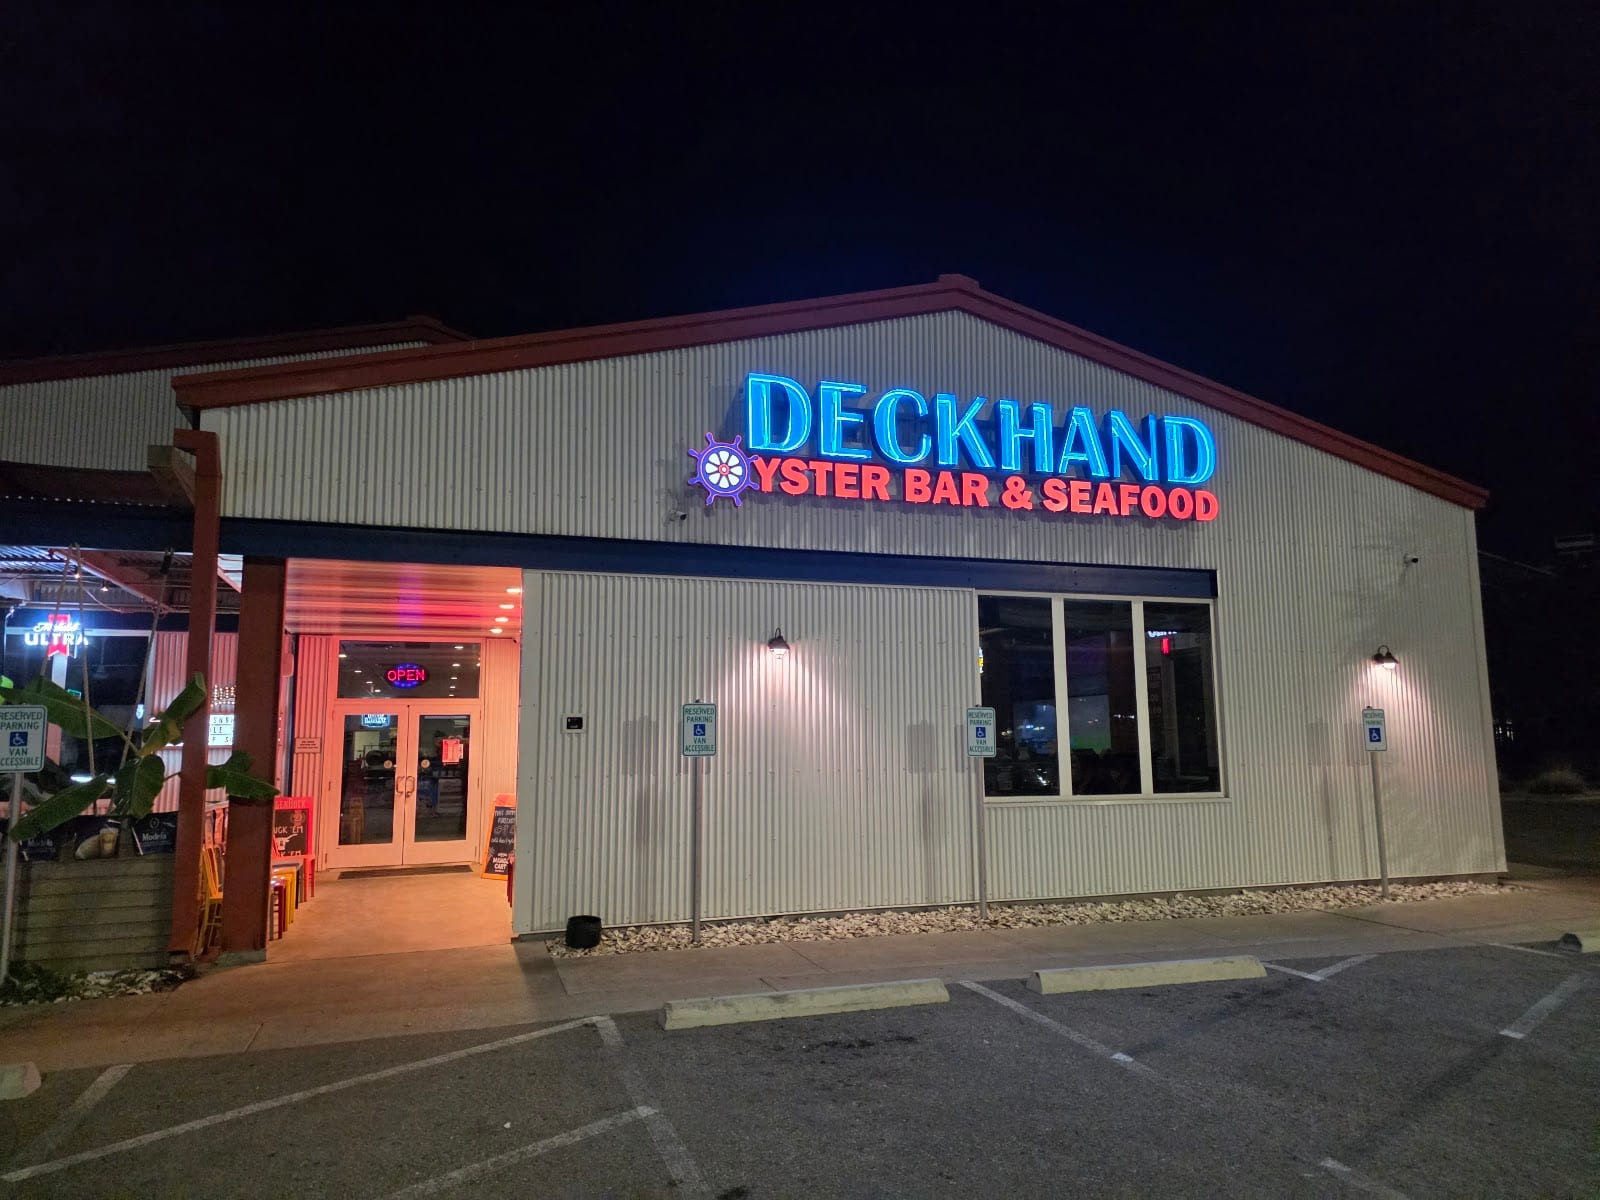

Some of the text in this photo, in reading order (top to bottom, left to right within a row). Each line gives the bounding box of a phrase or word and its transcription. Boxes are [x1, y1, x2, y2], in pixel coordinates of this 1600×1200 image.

[747, 372, 1217, 485] DECKHAND
[905, 468, 989, 507] BAR
[1001, 475, 1033, 510] &
[1043, 478, 1219, 522] SEAFOOD
[24, 632, 89, 646] ULTRA
[387, 669, 425, 681] OPEN
[0, 711, 43, 720] RESERVED
[0, 722, 39, 730] PARKING
[9, 748, 28, 756] VAN
[0, 757, 39, 766] CCESSIBLE
